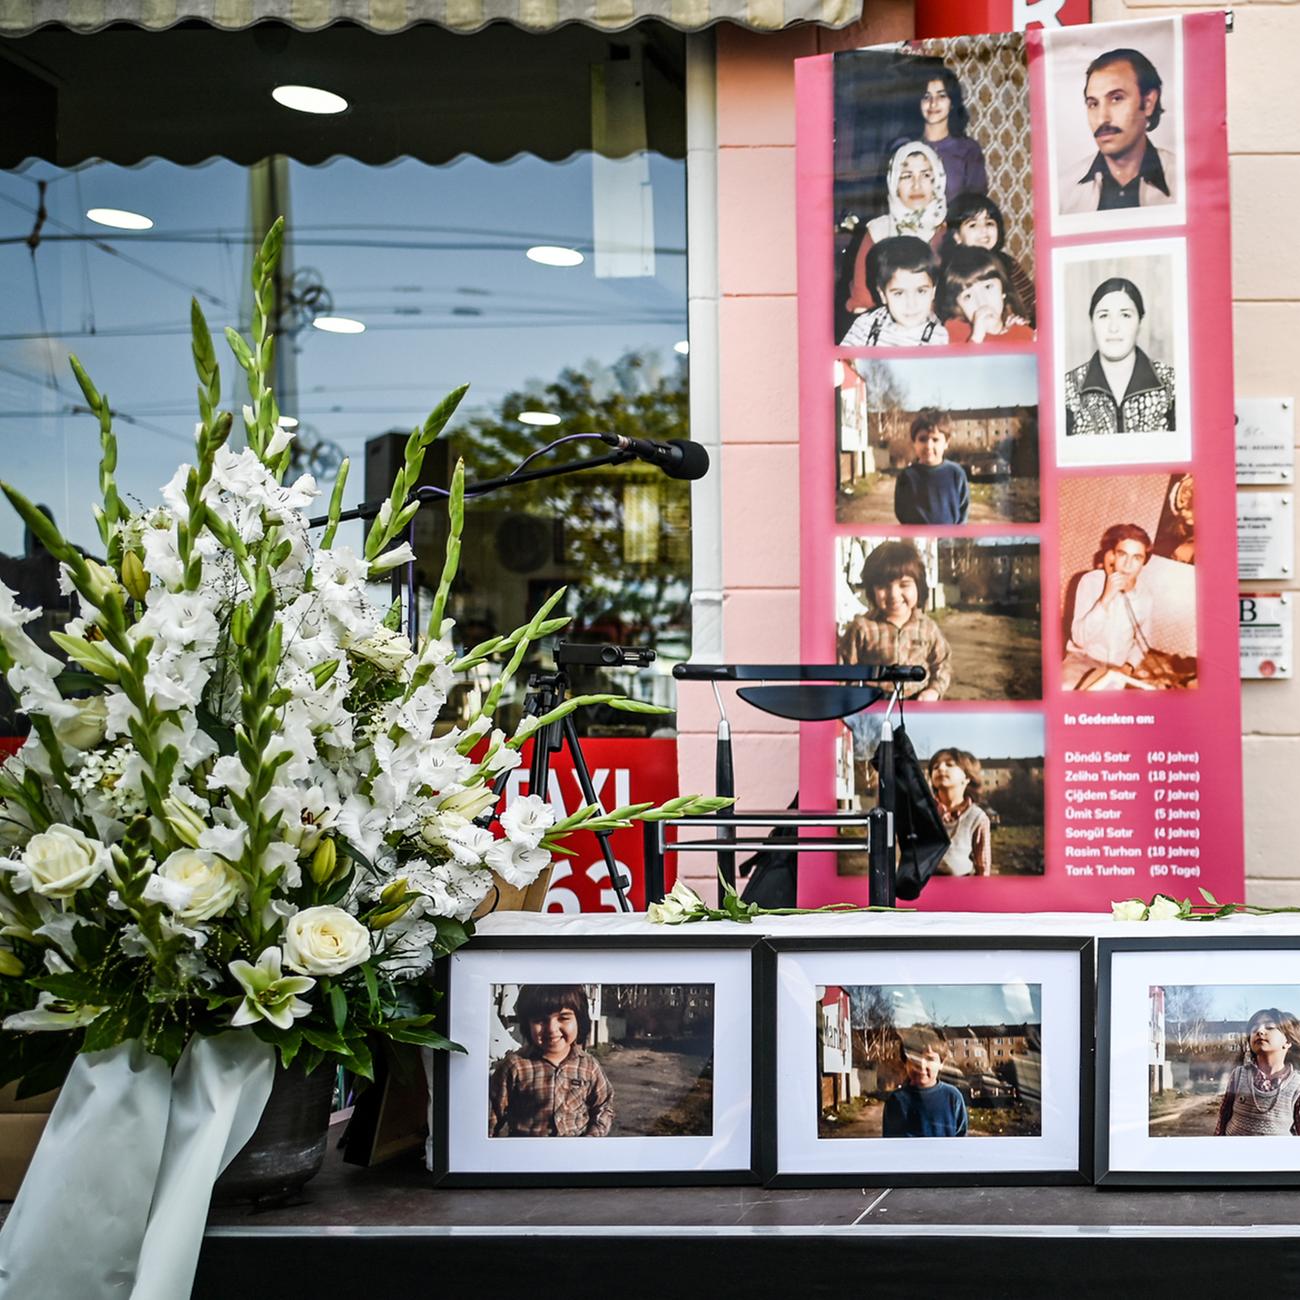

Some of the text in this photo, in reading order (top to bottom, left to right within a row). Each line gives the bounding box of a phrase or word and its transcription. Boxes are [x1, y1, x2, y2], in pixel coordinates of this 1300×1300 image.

[1063, 712, 1155, 725] In Gedenken an:
[1147, 751, 1166, 764] (40
[1167, 751, 1200, 764] Jahre)
[1064, 770, 1200, 783] Zeliha Turhan (18 Jahre)
[1064, 789, 1108, 802] Çiğdem
[1154, 789, 1165, 802] (7
[1167, 789, 1200, 802] Jahre)
[1064, 806, 1093, 820] Ümit
[1155, 806, 1166, 821] (5
[1168, 806, 1200, 821] Jahre)
[1065, 827, 1105, 841] Songül
[1154, 827, 1166, 841] (4
[1168, 827, 1200, 841] Jahre)
[1065, 845, 1200, 858] Rasim Turhan (18 Jahre)
[1095, 864, 1135, 877] Turhan
[1150, 864, 1169, 878] (50
[1170, 864, 1201, 878] Tage)
